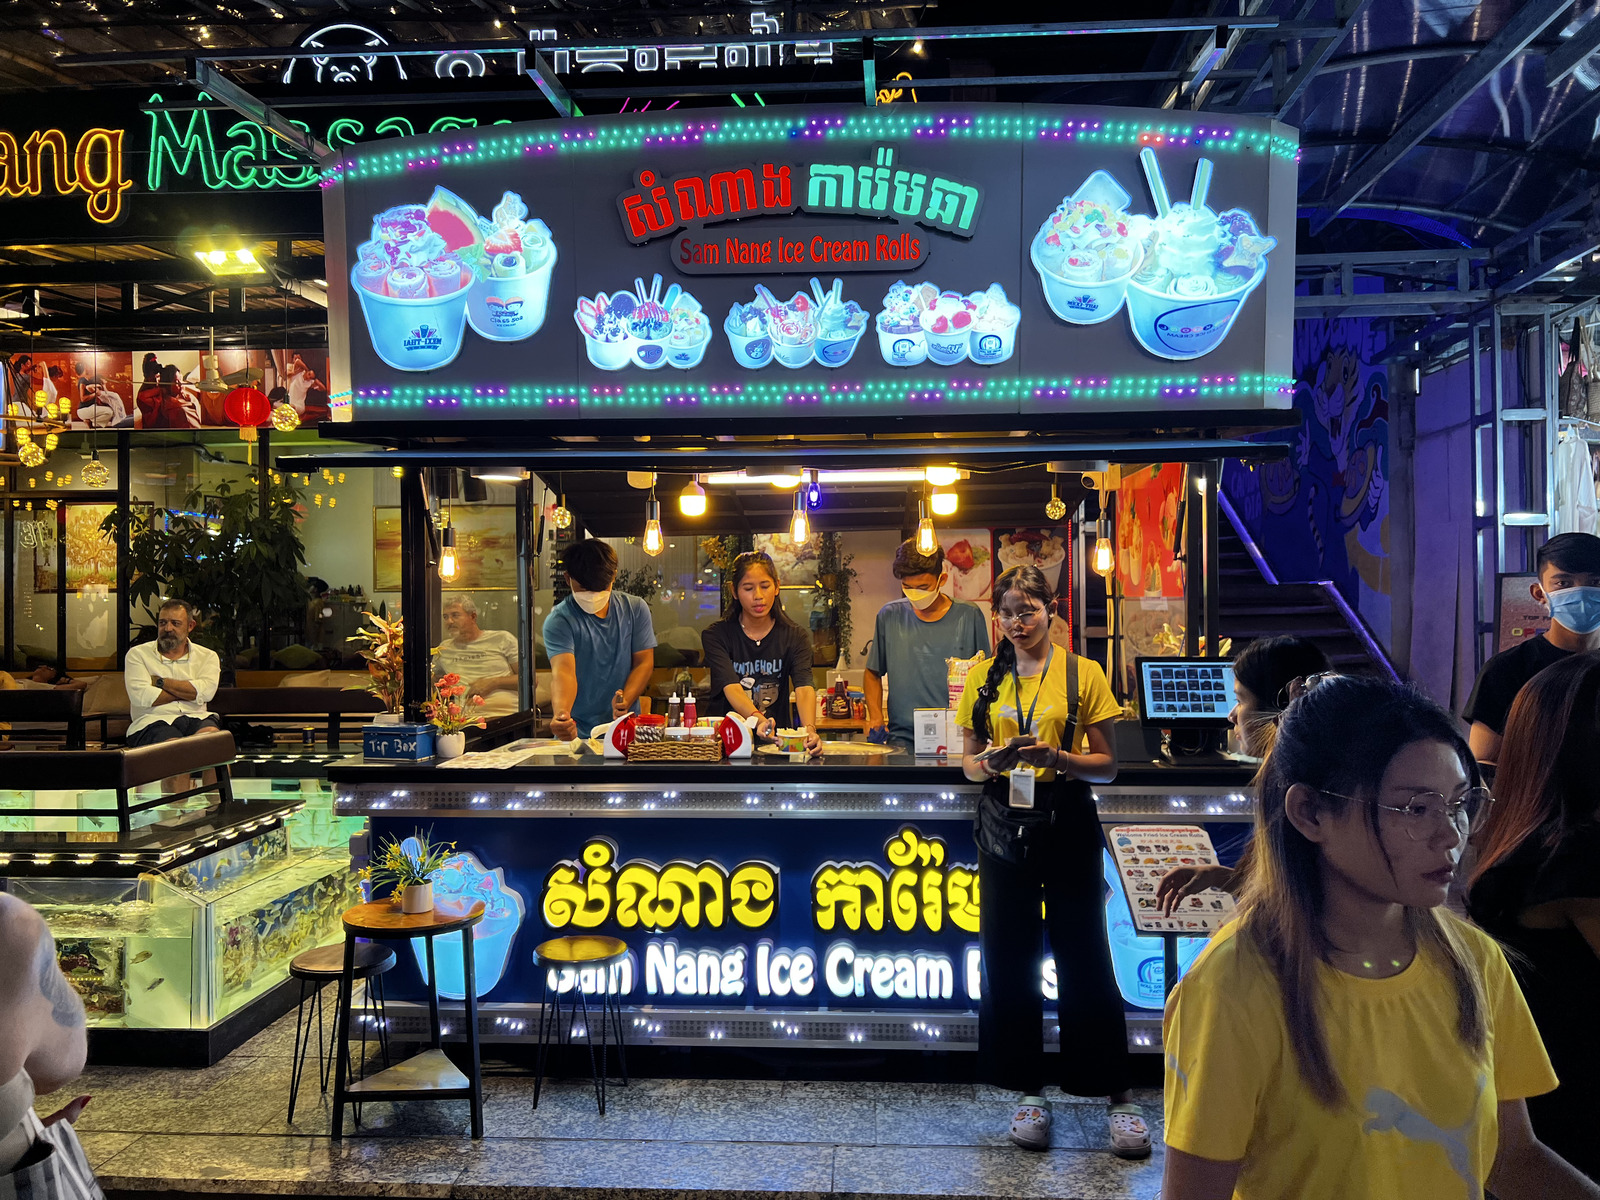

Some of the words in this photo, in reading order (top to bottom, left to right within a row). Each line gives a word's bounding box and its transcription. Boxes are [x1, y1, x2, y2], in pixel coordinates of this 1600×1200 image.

[623, 163, 792, 238] សំណាង
[680, 238, 720, 265] Sam
[725, 237, 773, 264] Nang
[778, 236, 805, 262] Ice
[810, 235, 870, 262] Cream
[875, 233, 921, 261] Rolls
[393, 738, 417, 753] Box
[542, 843, 775, 930] សំណាង
[646, 943, 746, 997] Nang
[756, 943, 813, 996] Ice
[824, 945, 954, 998] Cream
